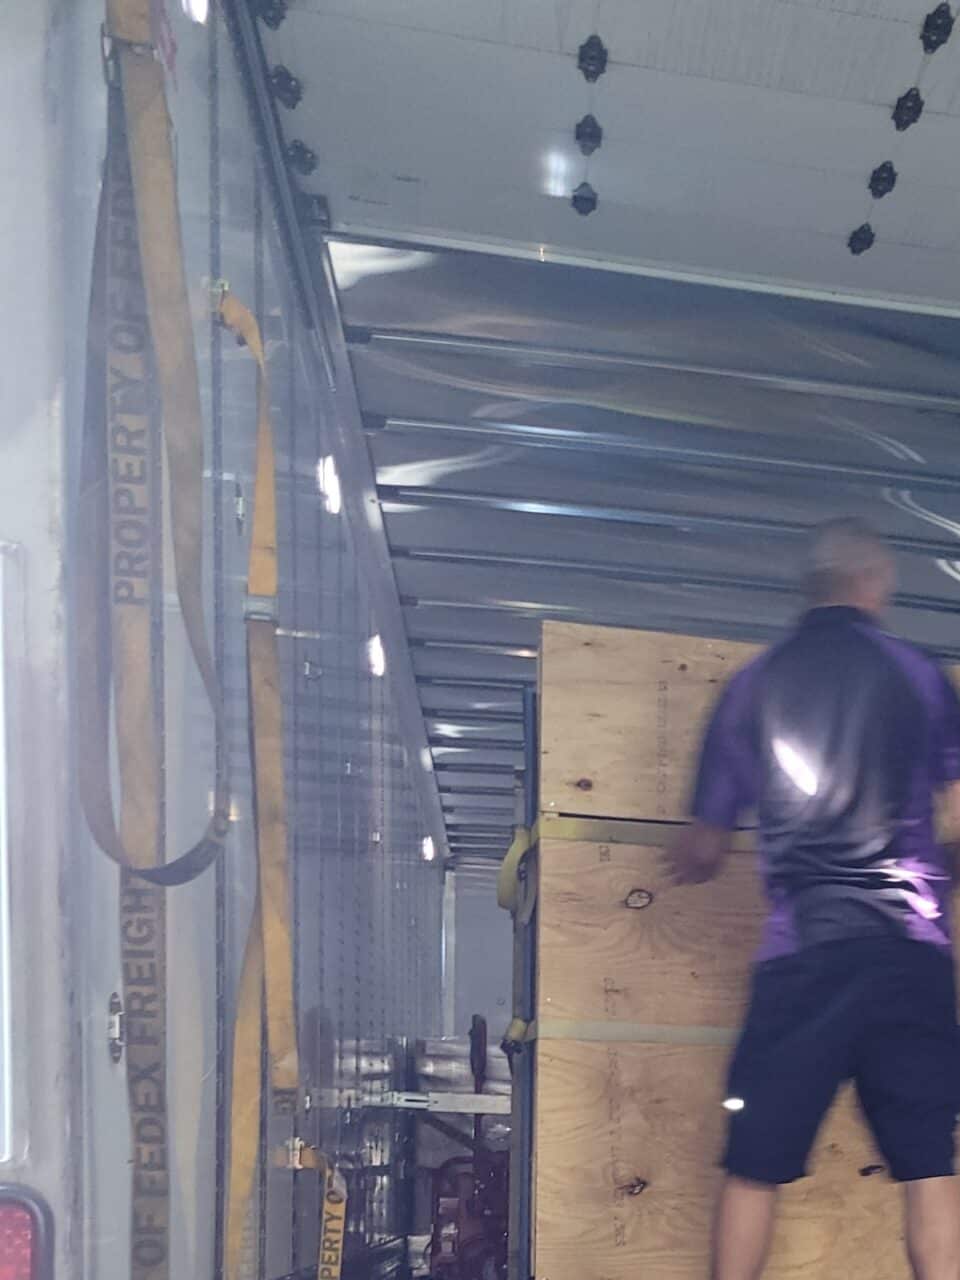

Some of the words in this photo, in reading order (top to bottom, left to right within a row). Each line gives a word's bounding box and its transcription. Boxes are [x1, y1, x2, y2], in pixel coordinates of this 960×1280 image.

[110, 363, 150, 606] PROPERTY
[130, 1060, 168, 1198] FEDEX
[133, 1206, 168, 1267] OF
